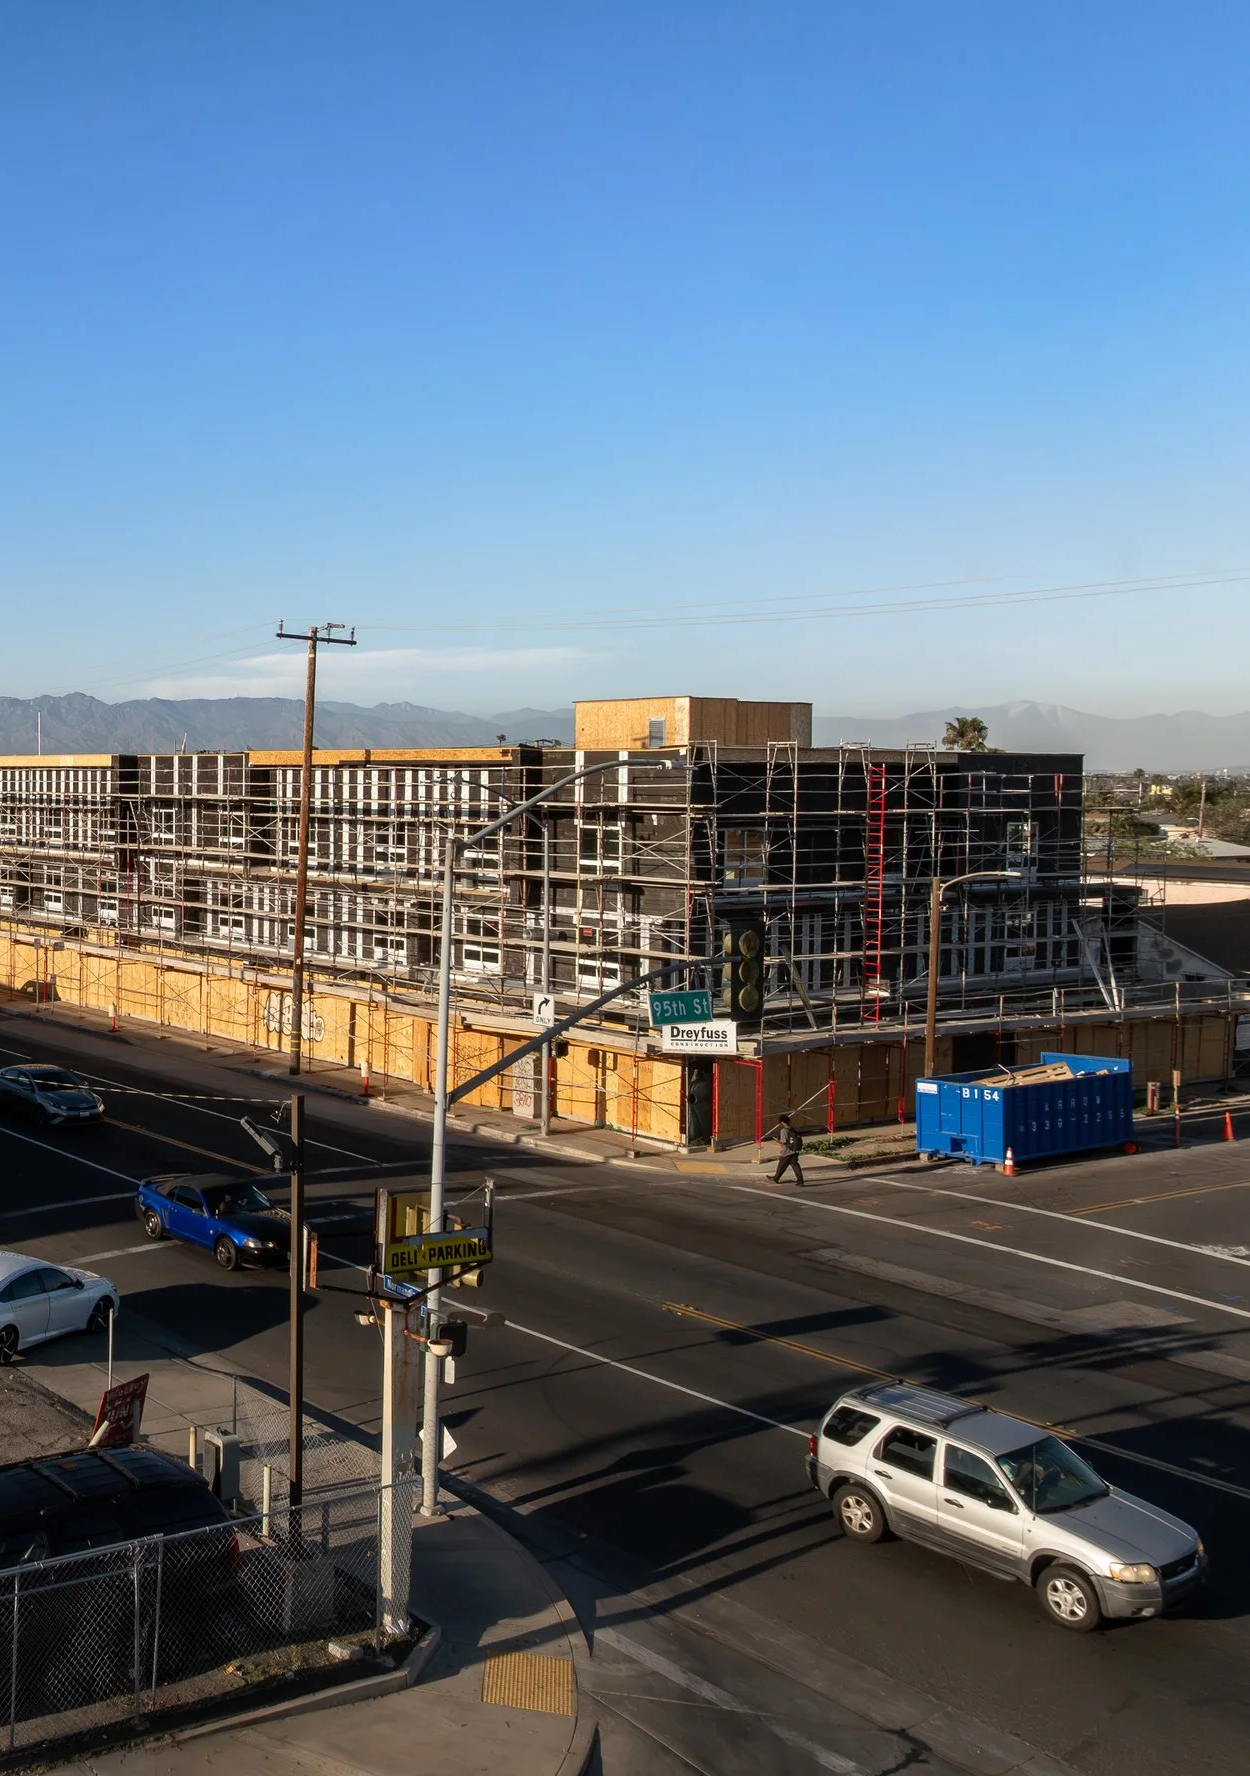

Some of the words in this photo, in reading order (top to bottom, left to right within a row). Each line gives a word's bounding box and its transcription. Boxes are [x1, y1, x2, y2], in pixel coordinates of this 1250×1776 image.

[653, 1000, 687, 1017] 95th
[693, 997, 709, 1015] St
[535, 1016, 552, 1025] ONLY
[670, 1026, 728, 1042] Dreyfuss
[391, 1249, 418, 1268] DELI
[428, 1238, 487, 1262] PARKING
